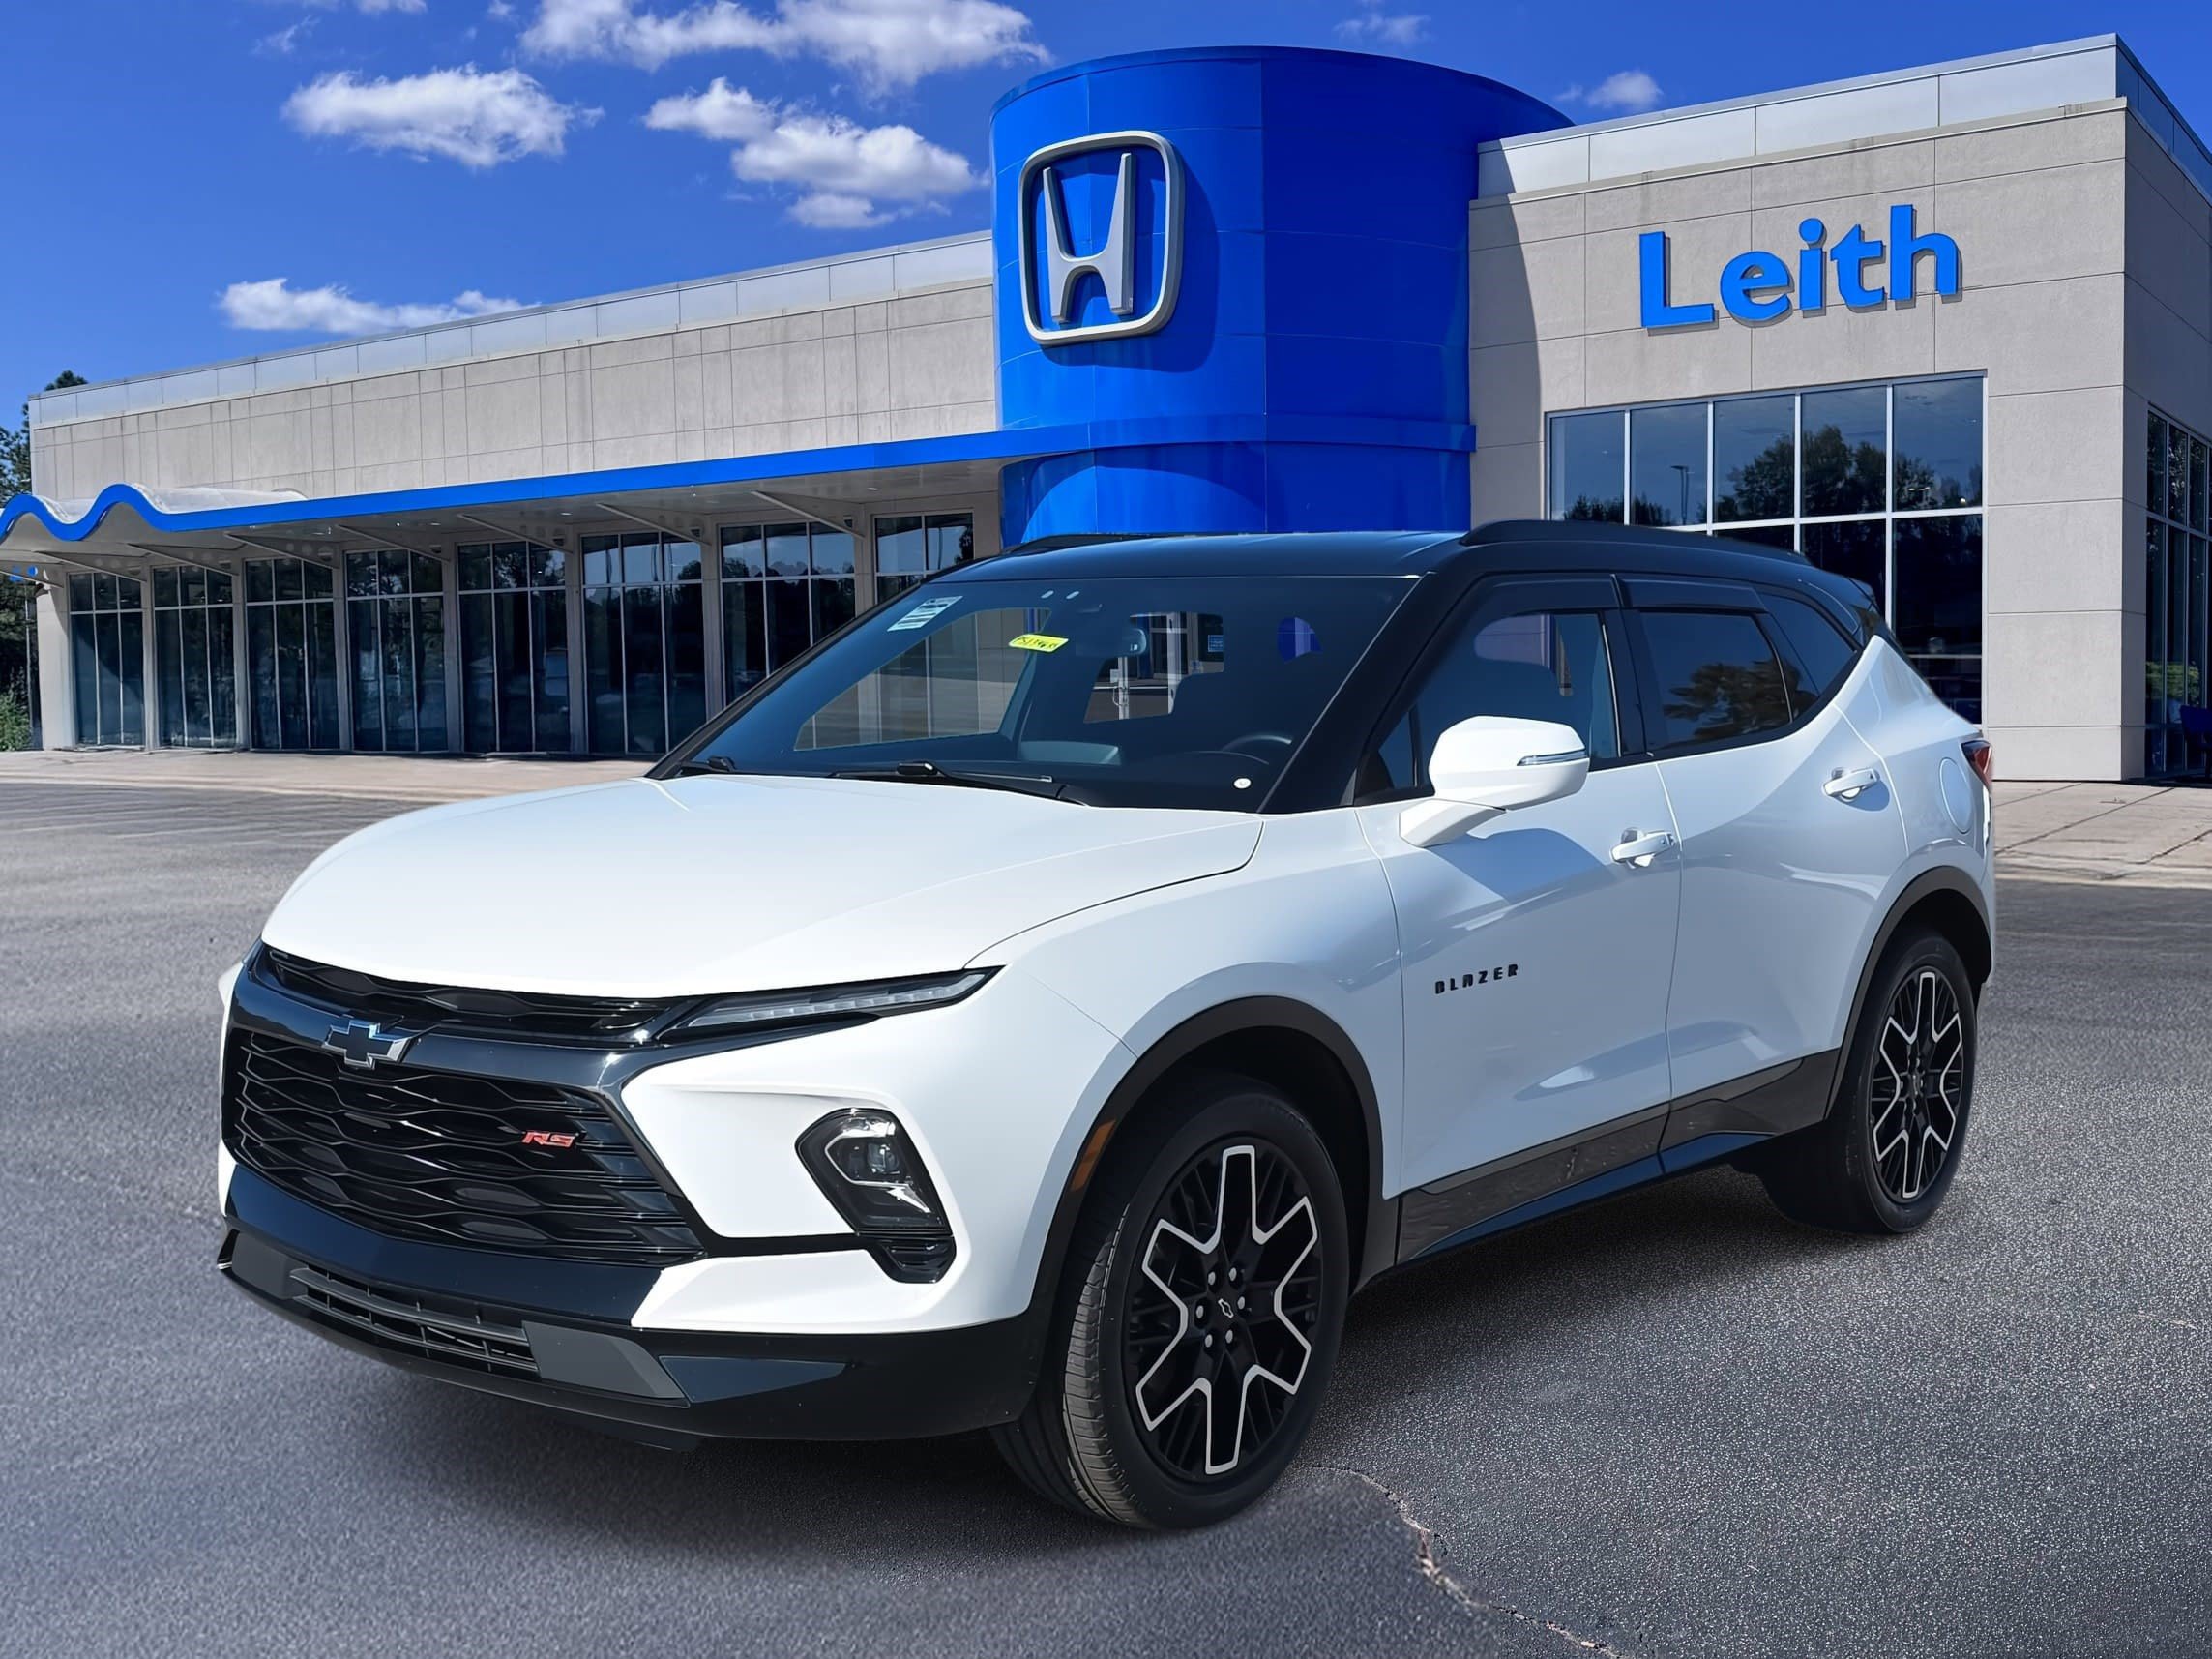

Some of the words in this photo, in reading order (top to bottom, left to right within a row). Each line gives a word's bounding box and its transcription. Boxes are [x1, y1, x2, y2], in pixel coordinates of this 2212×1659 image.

[1639, 204, 1961, 331] Leith
[1435, 963, 1519, 994] BLAZER
[522, 1131, 575, 1148] RS
